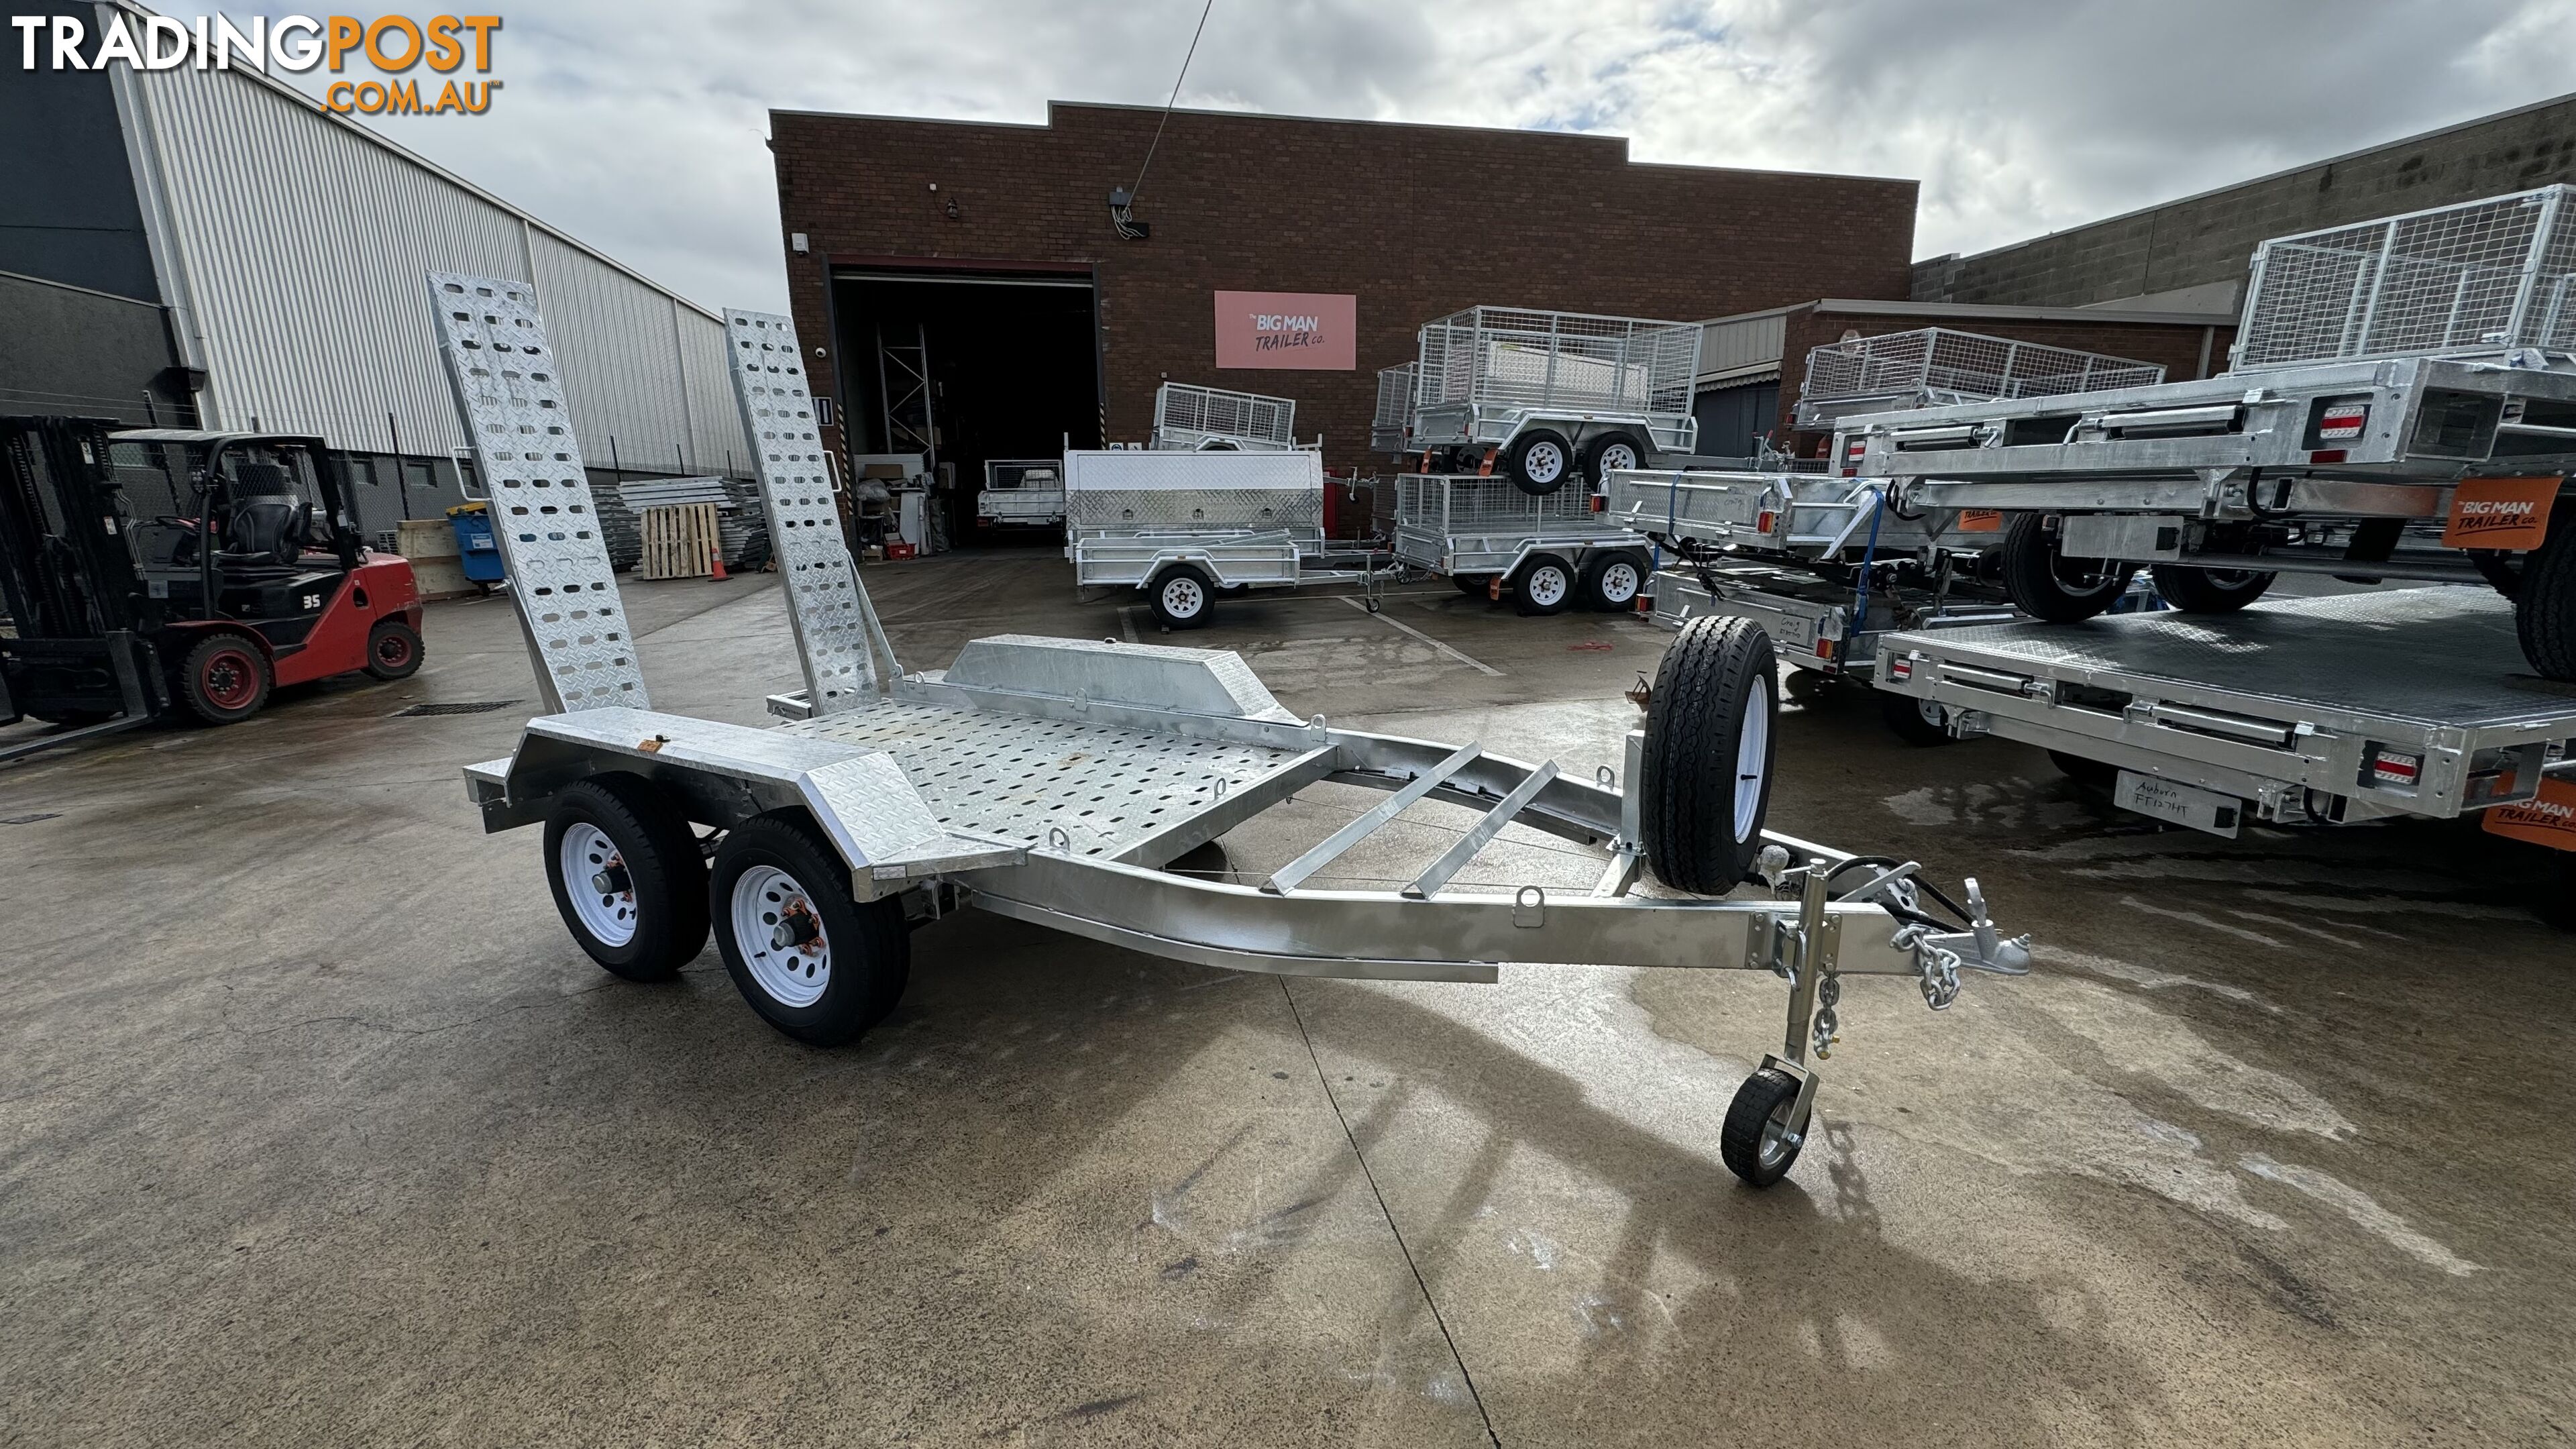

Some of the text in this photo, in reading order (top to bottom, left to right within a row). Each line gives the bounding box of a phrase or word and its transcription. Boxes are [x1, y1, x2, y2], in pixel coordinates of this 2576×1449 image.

[1256, 315, 1282, 331] BIG
[1283, 315, 1318, 331] MAN
[1256, 332, 1309, 352] TRAILER
[2462, 502, 2492, 514] BIG
[2490, 502, 2534, 514] MAN
[2458, 514, 2518, 529] TRAILER
[303, 594, 321, 609] 35
[2136, 782, 2177, 798] Auburn
[2498, 808, 2561, 826] TRAILER
[2532, 800, 2575, 818] MAN
